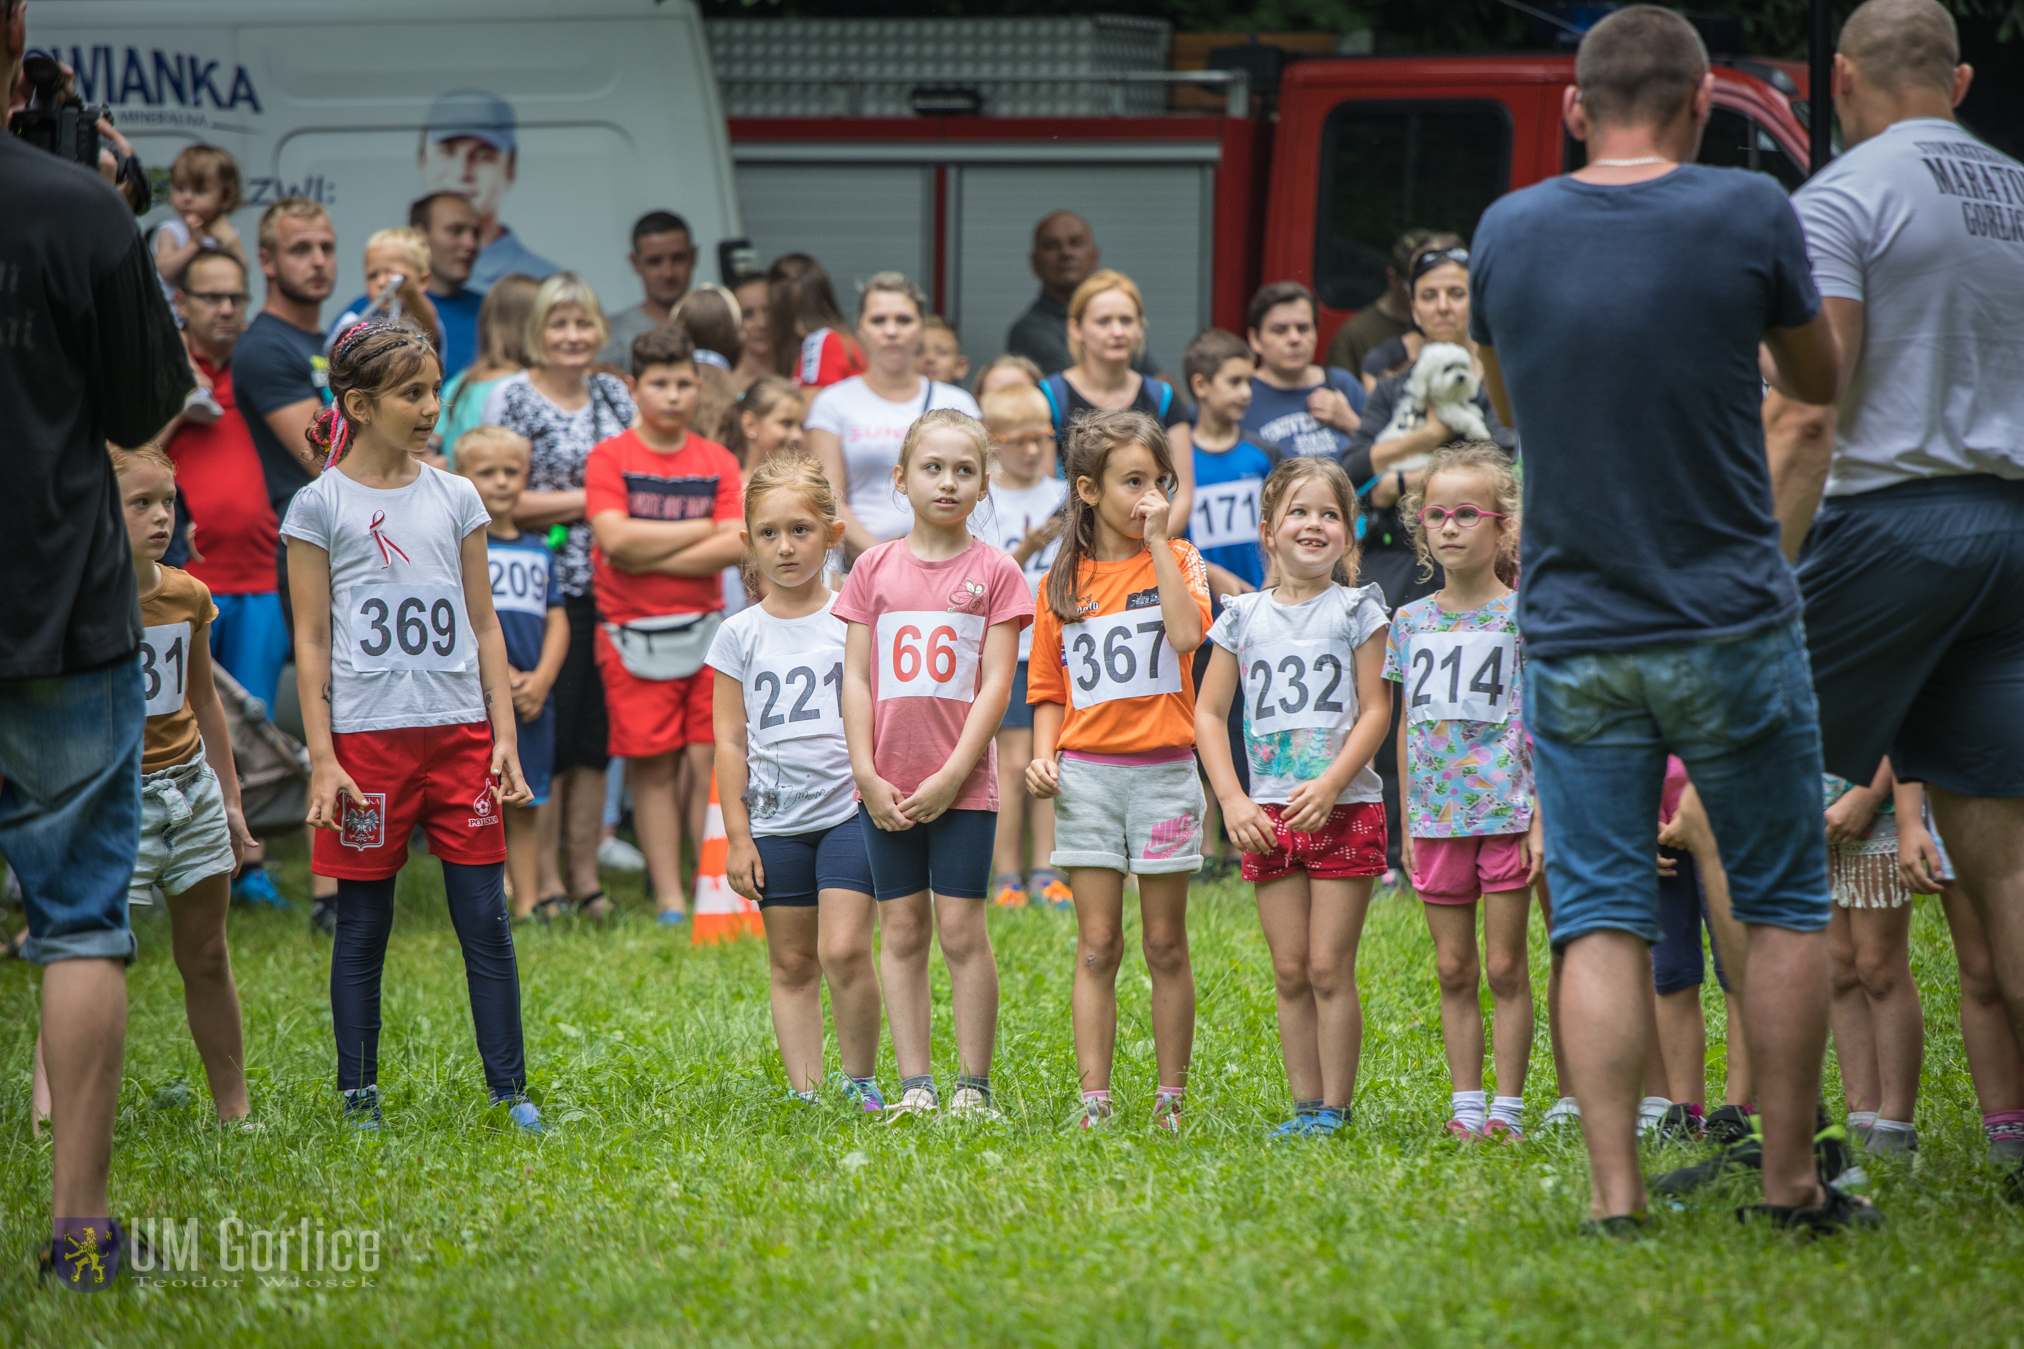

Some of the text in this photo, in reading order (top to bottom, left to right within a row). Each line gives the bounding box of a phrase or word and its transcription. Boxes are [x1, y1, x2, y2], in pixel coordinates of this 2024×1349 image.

[23, 46, 264, 114] WIANKA
[1921, 157, 2024, 206] MARATO
[1961, 200, 2024, 241] GORLIC
[1198, 493, 1257, 535] 171
[488, 560, 544, 600] 209
[360, 597, 456, 657] 369
[892, 625, 958, 683] 66
[1072, 620, 1168, 692] 367
[754, 661, 843, 731] 221
[1250, 654, 1344, 721] 232
[1411, 645, 1504, 707] 214
[468, 815, 499, 828] POLSKA
[1150, 812, 1192, 848] NIKE
